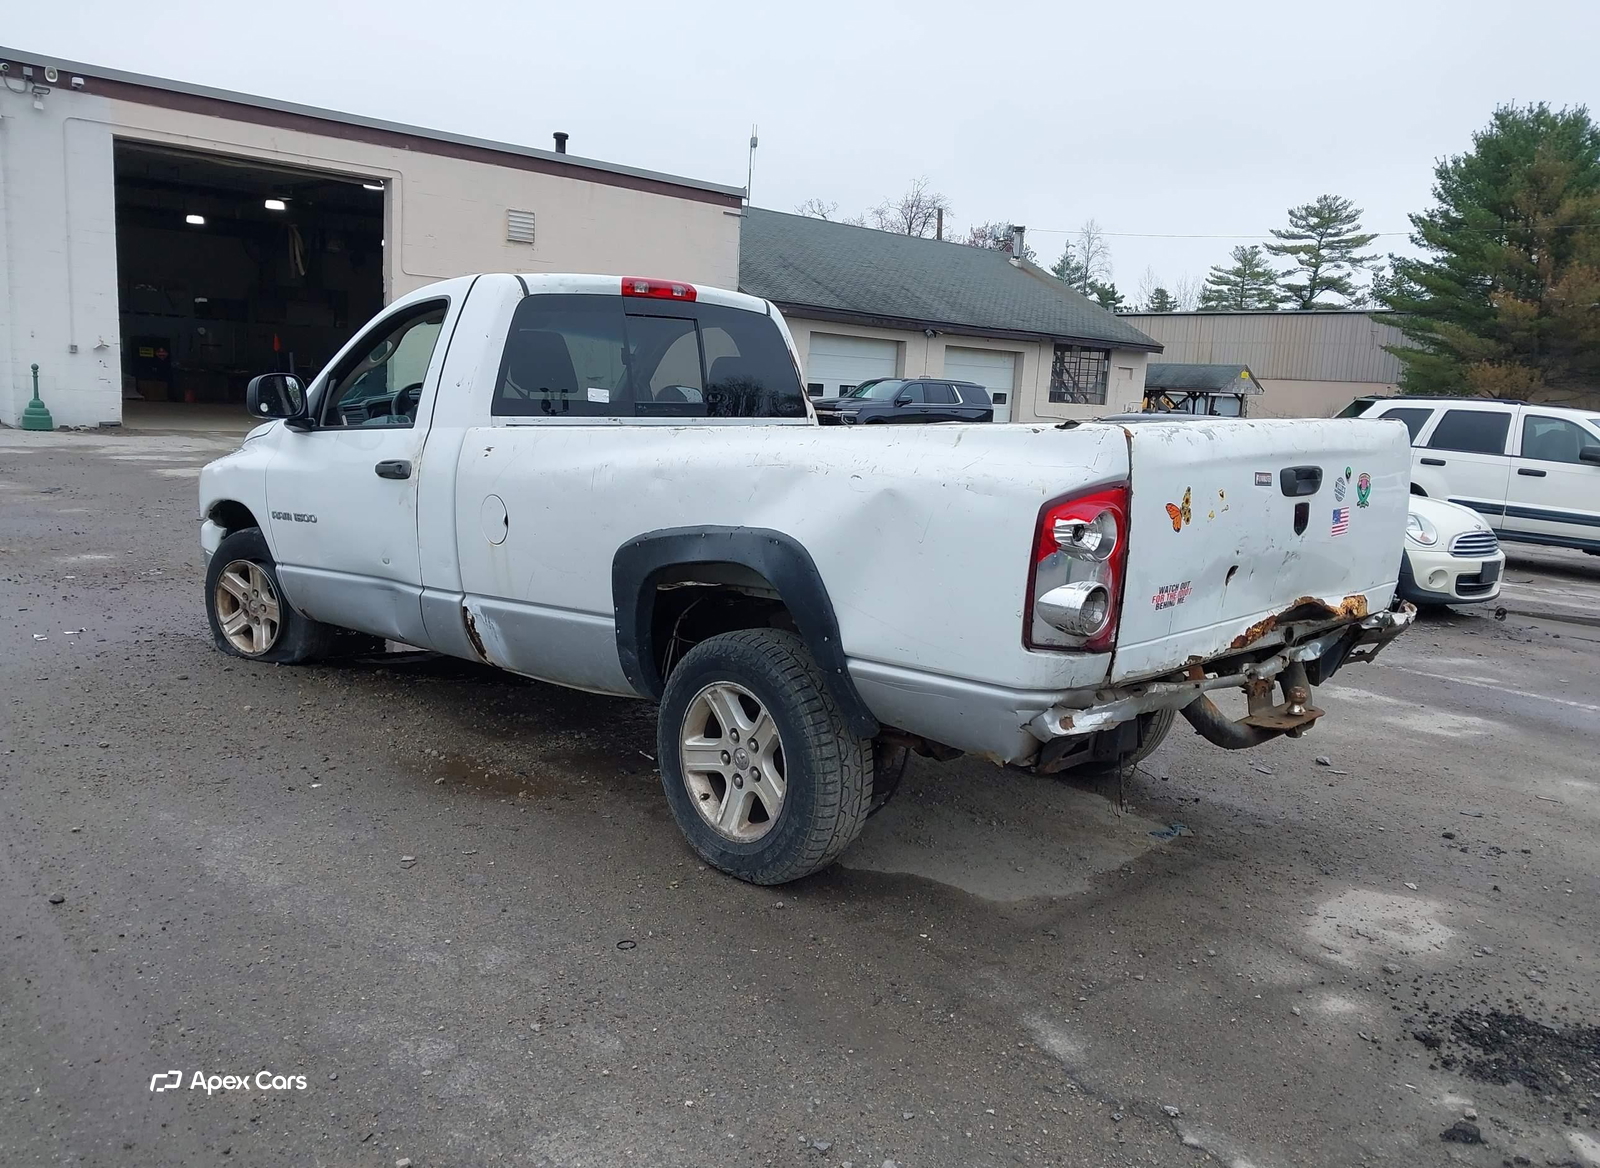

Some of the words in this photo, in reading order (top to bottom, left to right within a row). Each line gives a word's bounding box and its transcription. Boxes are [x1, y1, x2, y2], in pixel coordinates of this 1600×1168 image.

[271, 511, 292, 521] RAM
[293, 513, 318, 523] 1500
[1158, 584, 1179, 595] WATCH
[1180, 580, 1191, 590] OUT
[1151, 594, 1165, 604] FOR
[1166, 591, 1177, 602] THE
[1155, 600, 1176, 611] BEHIND
[1177, 597, 1185, 605] ME
